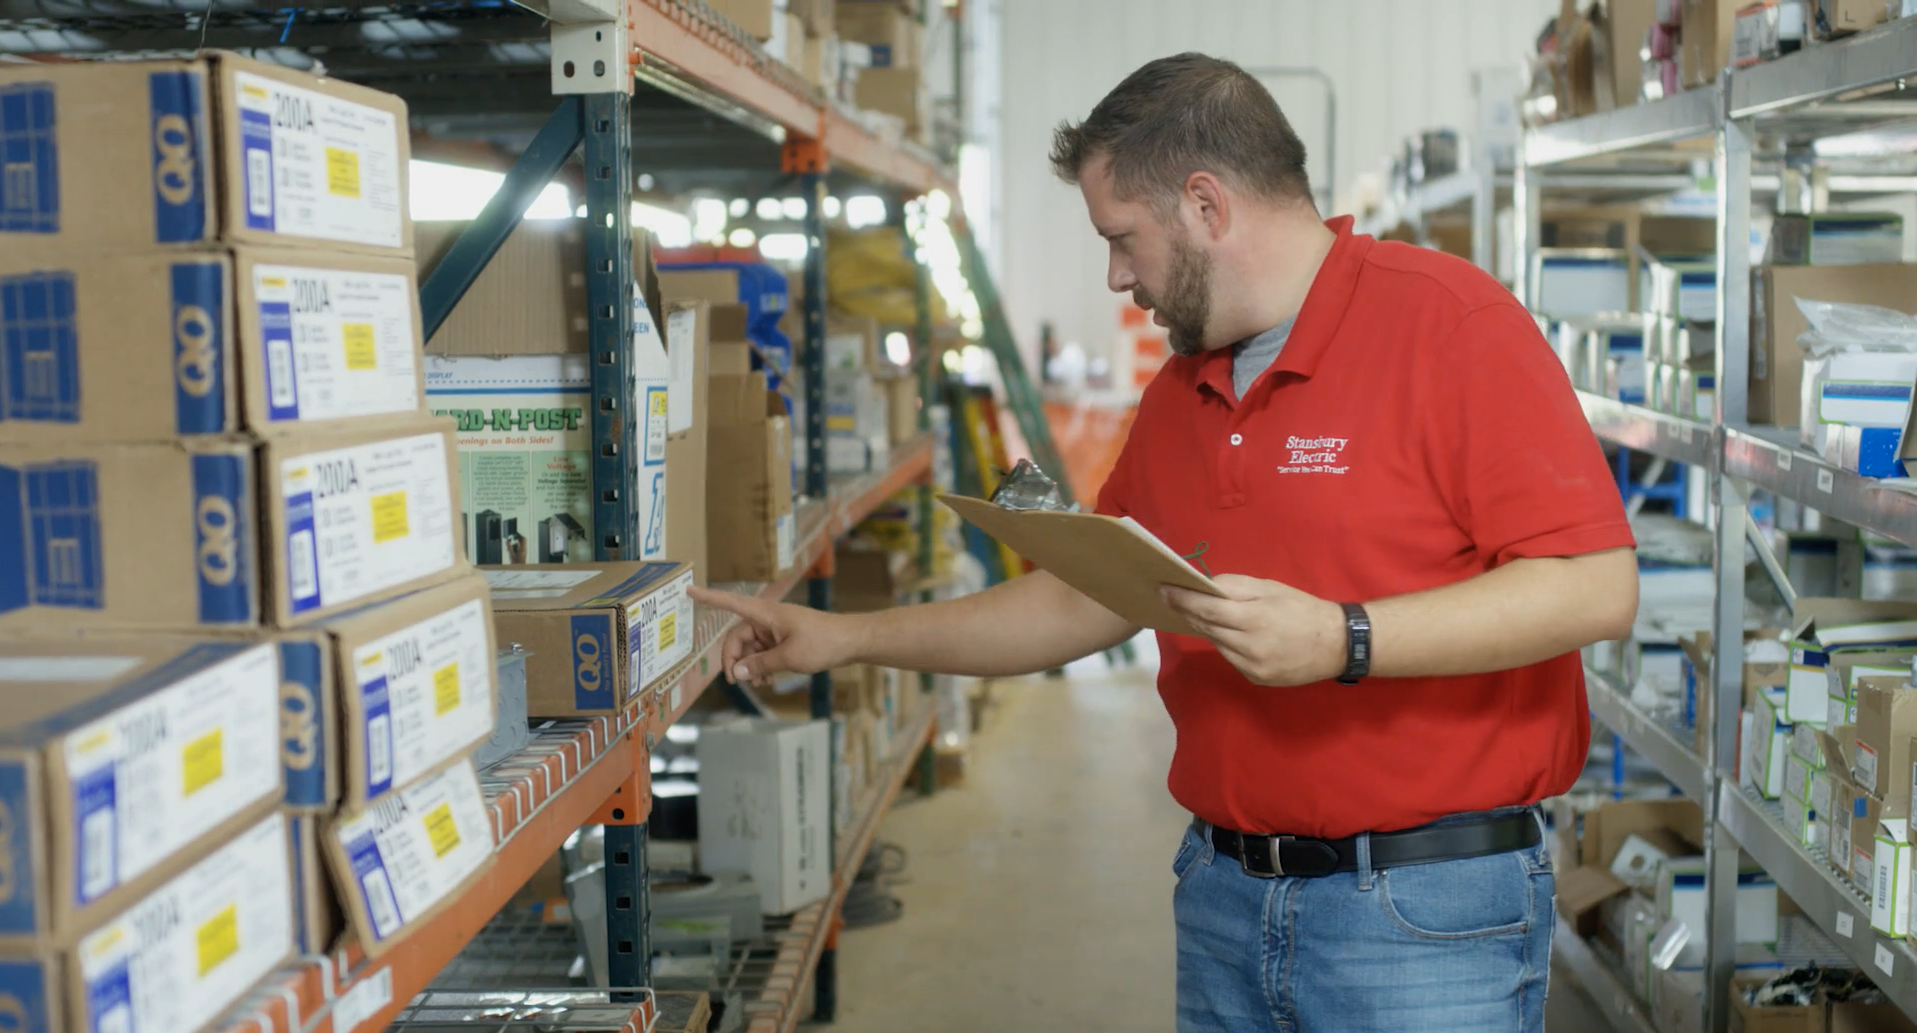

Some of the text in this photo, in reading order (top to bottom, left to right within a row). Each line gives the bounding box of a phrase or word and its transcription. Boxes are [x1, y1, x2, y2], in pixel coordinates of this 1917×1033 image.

[274, 92, 318, 134] 200A
[156, 113, 195, 205] QO
[293, 279, 333, 313] 200A
[177, 304, 217, 398] QO
[427, 372, 453, 380] DISPLAY
[431, 408, 581, 431] RD-N-POST
[491, 437, 502, 445] on
[505, 436, 526, 445] Both
[529, 436, 554, 445] Sides!
[1285, 435, 1348, 451] Stansbury
[1288, 449, 1336, 463] Electric
[317, 457, 360, 498] 200A
[198, 493, 237, 586] QO
[640, 595, 658, 628] 200A
[387, 637, 422, 680] 200A
[576, 633, 601, 691] QO
[280, 682, 318, 770] QO
